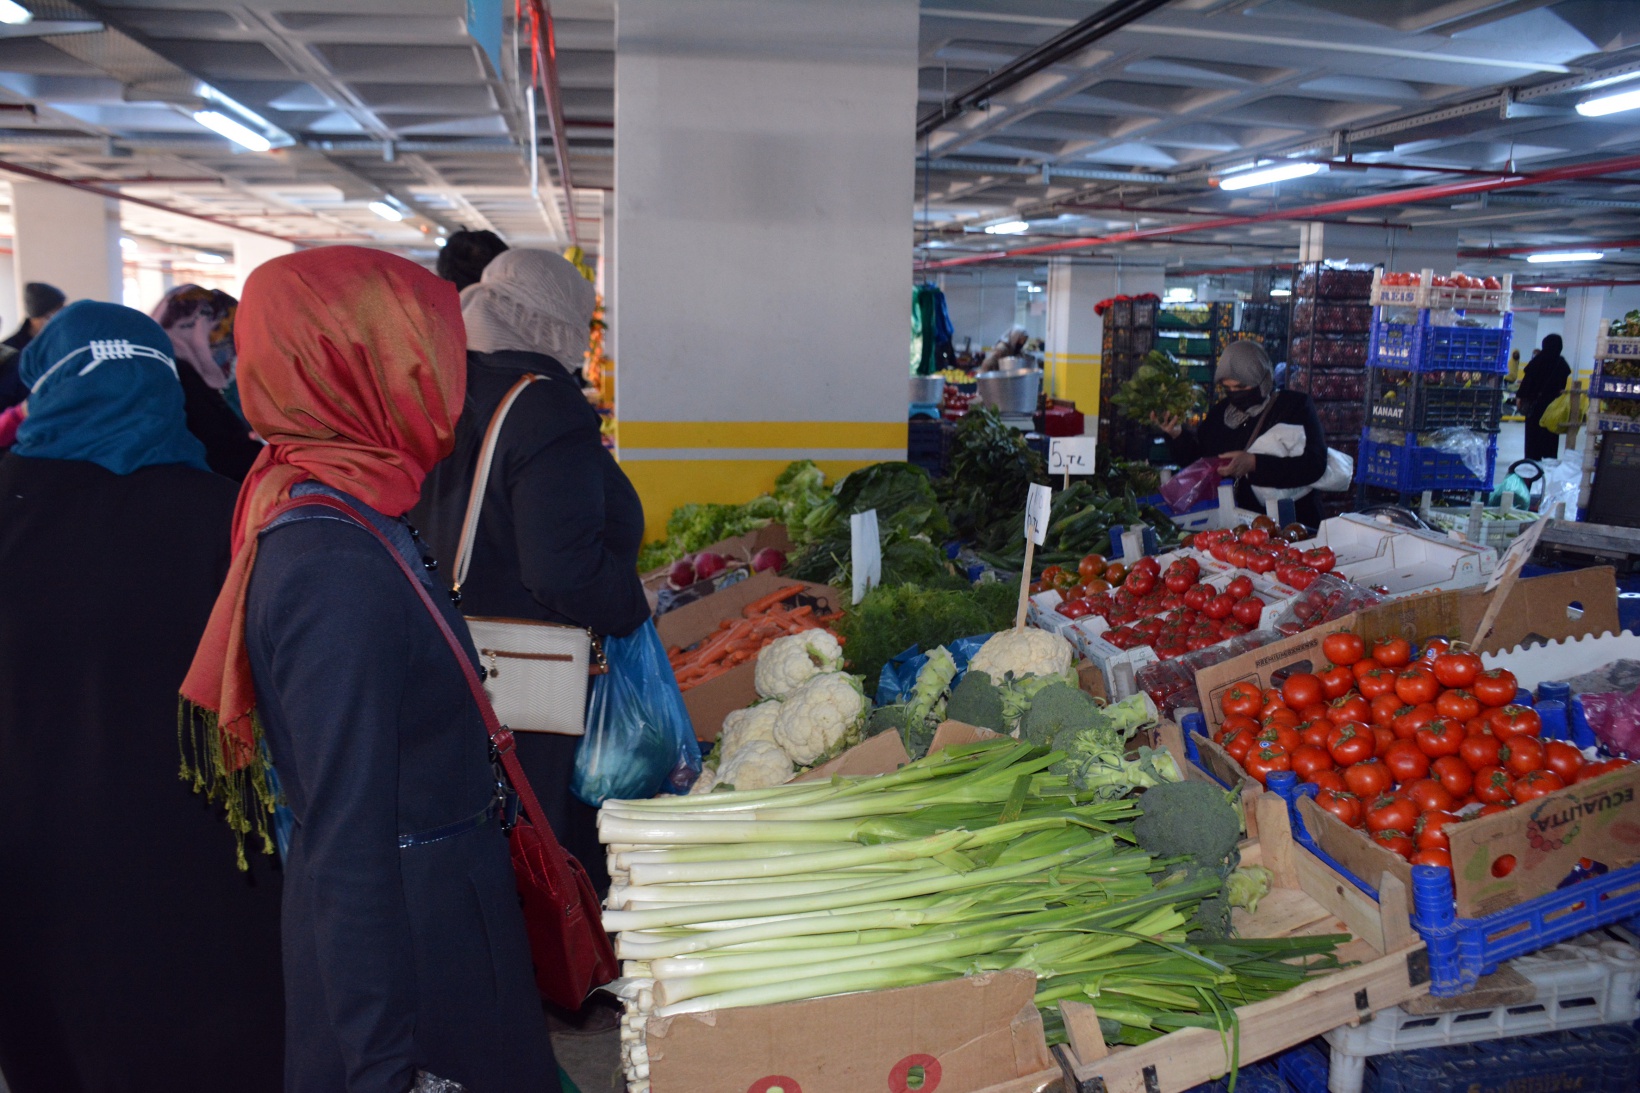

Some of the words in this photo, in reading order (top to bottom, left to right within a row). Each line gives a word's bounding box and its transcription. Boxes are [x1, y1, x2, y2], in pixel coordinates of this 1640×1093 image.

[1373, 405, 1404, 418] KANAAT
[1255, 648, 1287, 668] PREMIUM
[1287, 638, 1319, 657] BANANAS
[1536, 787, 1634, 832] ECUALITTA
